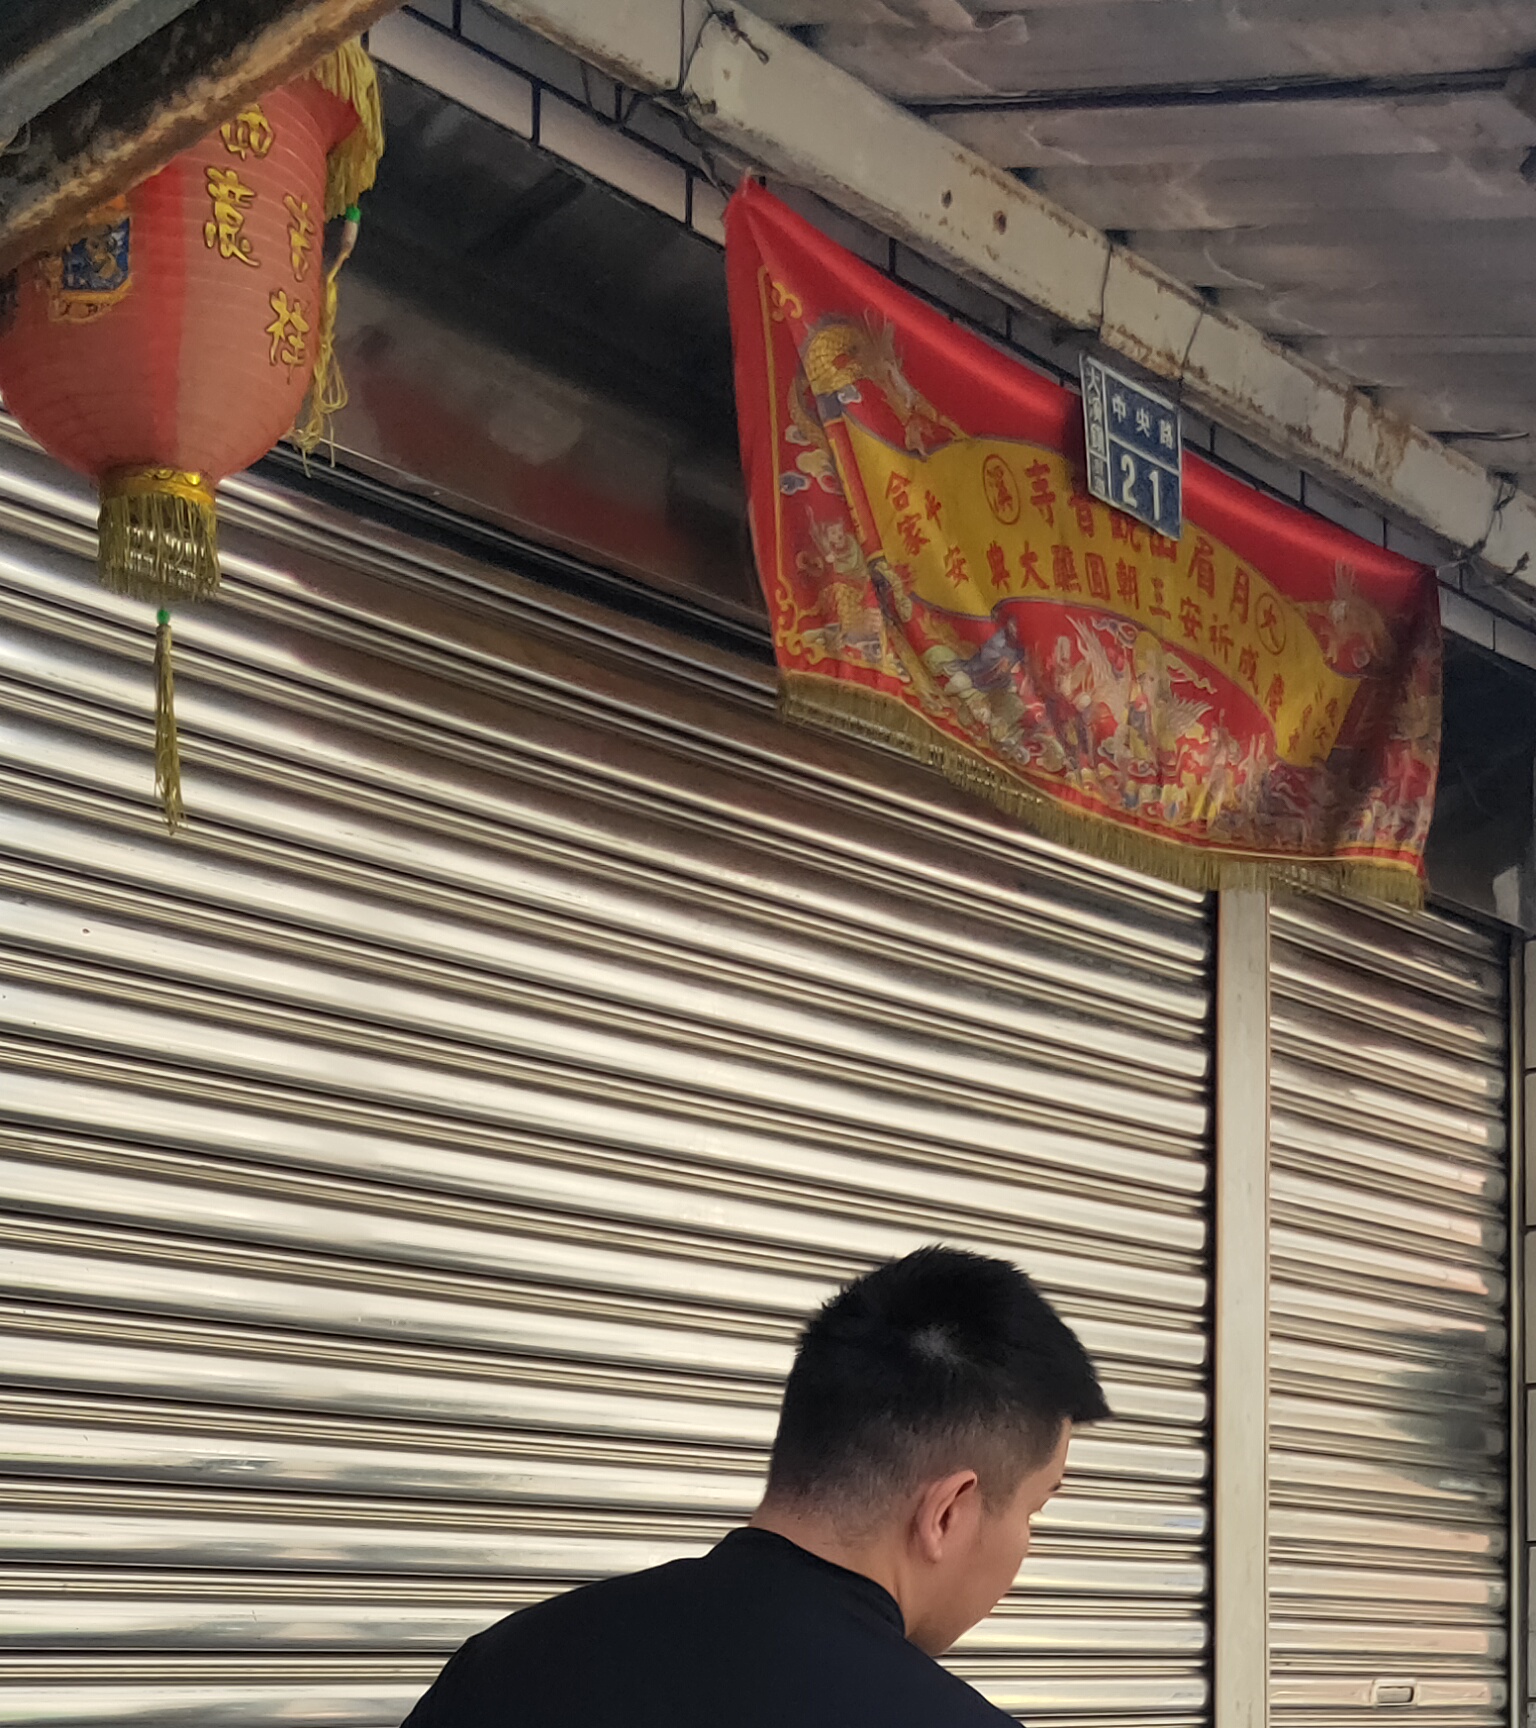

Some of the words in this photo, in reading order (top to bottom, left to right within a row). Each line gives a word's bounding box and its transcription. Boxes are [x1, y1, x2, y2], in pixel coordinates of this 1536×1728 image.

[1112, 396, 1174, 450] 中央路
[1120, 454, 1161, 522] 21
